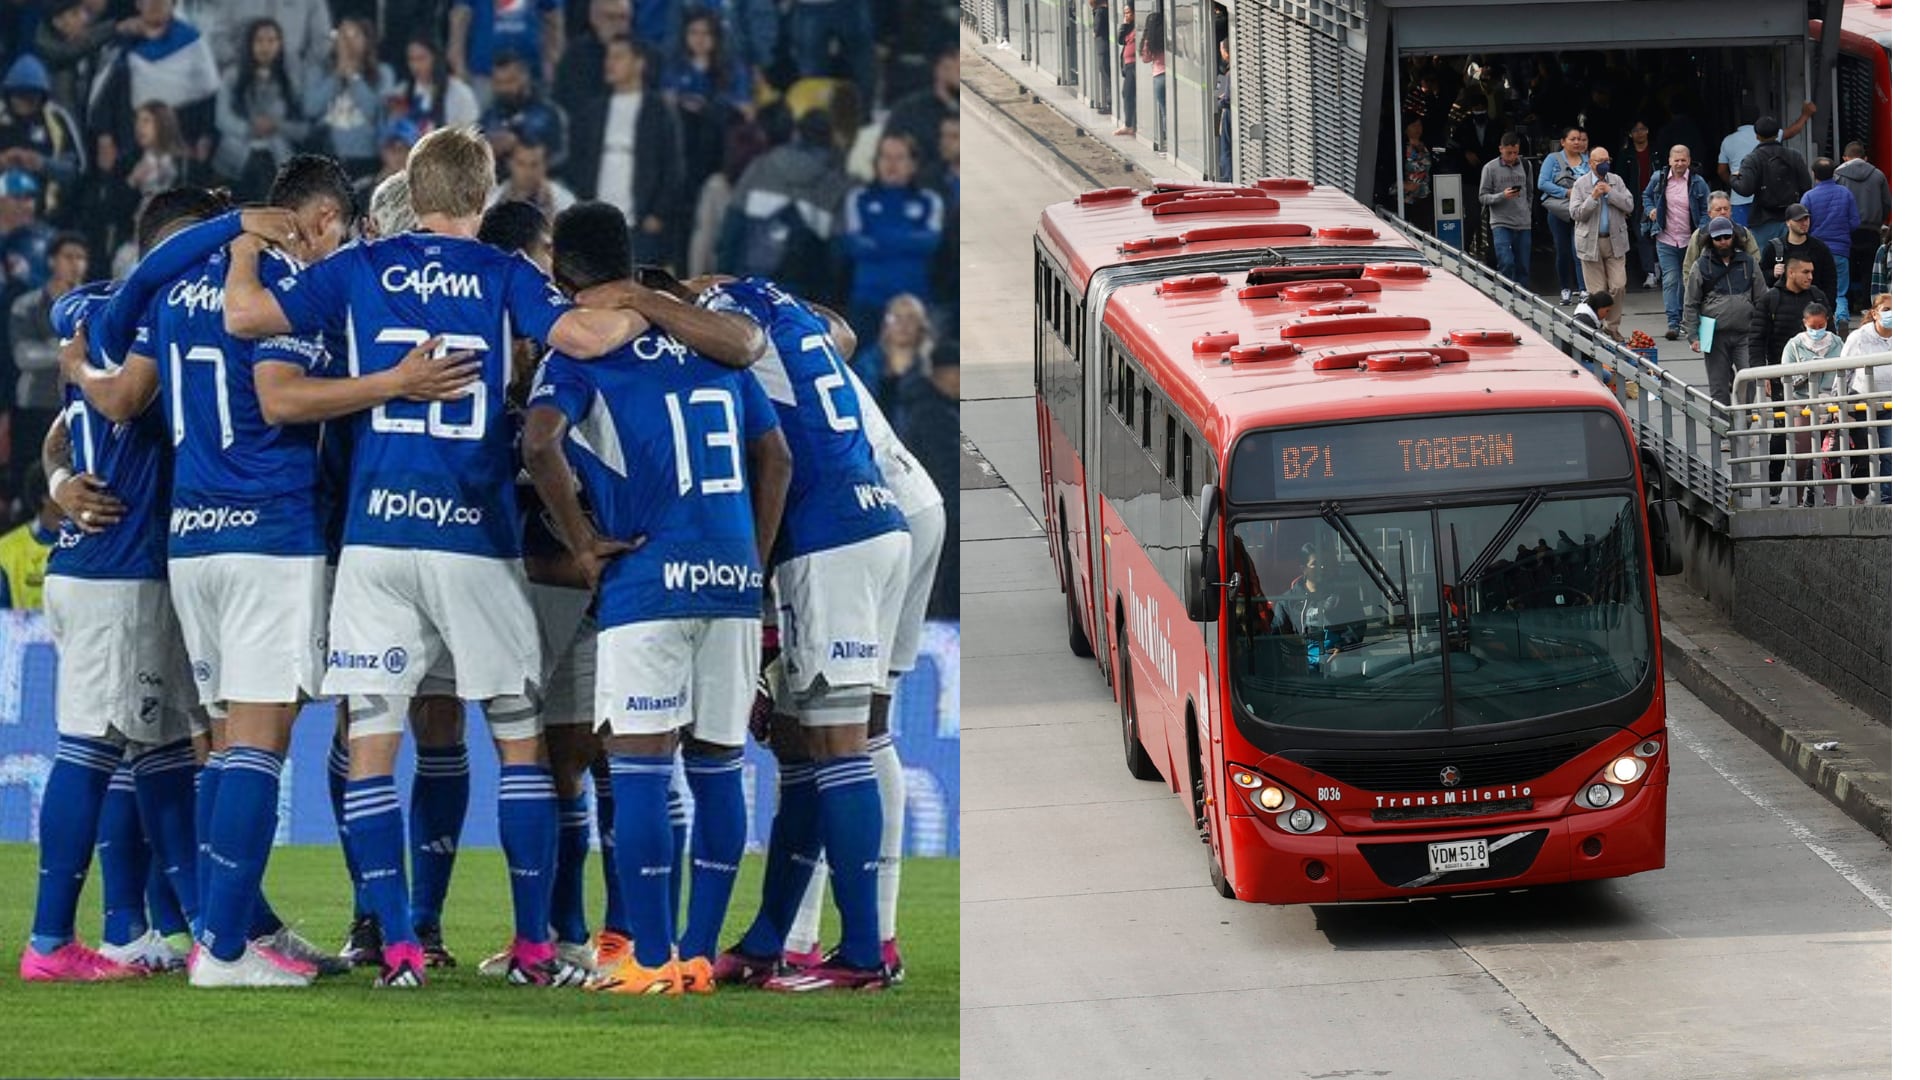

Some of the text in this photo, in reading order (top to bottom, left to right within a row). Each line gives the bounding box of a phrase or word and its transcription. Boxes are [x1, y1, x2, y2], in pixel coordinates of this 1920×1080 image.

[169, 342, 236, 450] 17
[665, 388, 745, 497] 13
[1282, 433, 1514, 480] B71 TOBERIN
[1317, 786, 1341, 802] B036
[1376, 785, 1531, 808] TransMilenio
[1431, 844, 1486, 864] VDM 518
